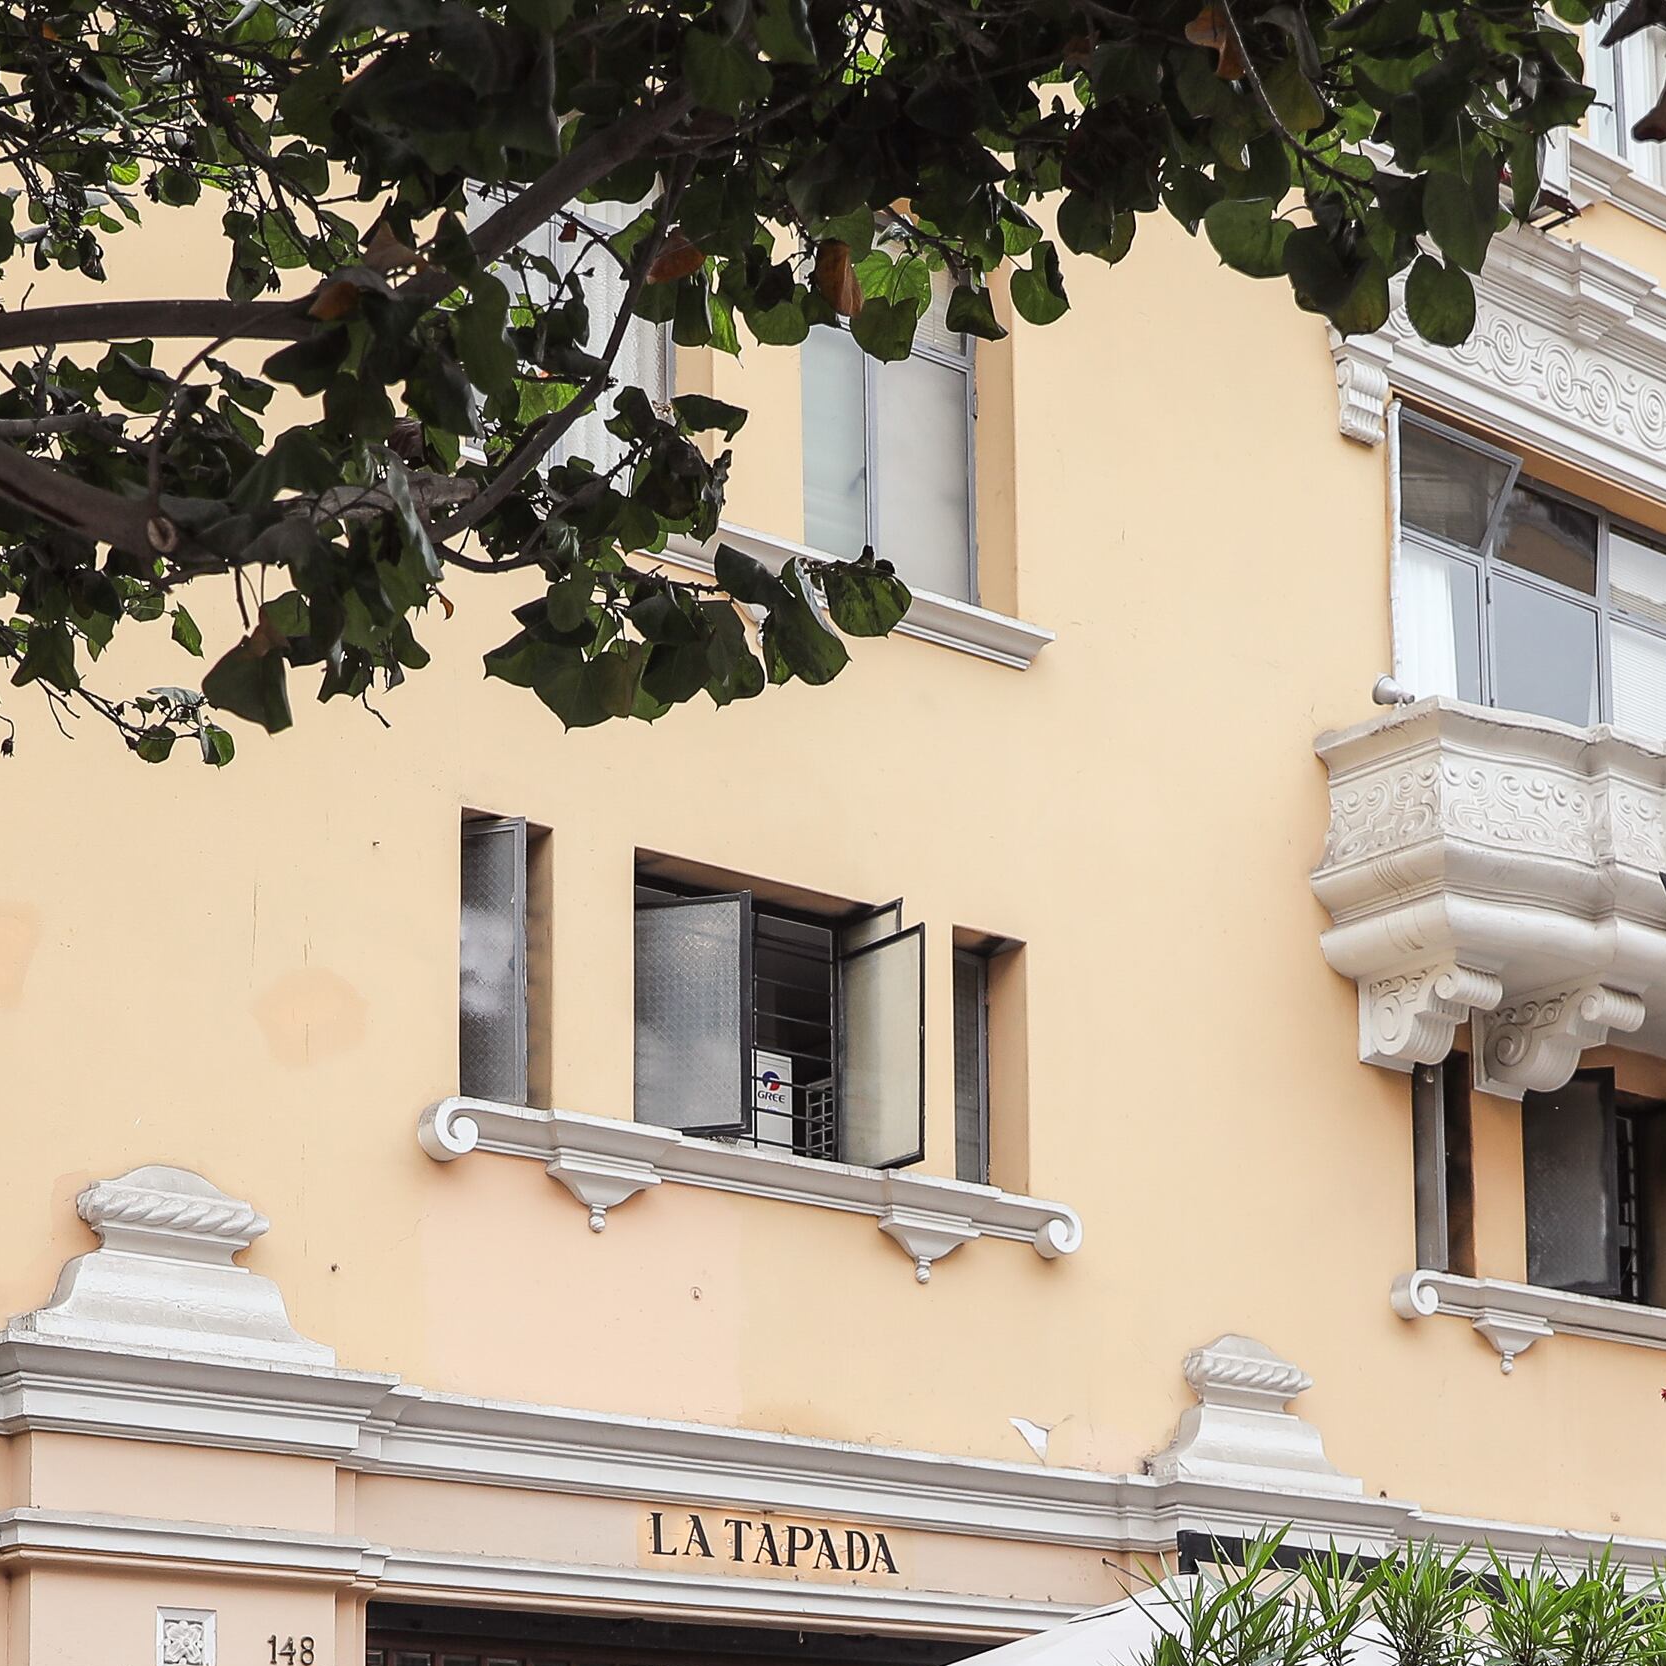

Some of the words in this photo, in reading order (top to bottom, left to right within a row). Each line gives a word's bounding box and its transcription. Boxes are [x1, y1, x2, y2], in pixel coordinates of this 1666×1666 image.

[757, 1090, 786, 1104] GREE
[649, 1512, 715, 1558] LA
[724, 1518, 900, 1575] TAPADA
[267, 1634, 315, 1666] 148
